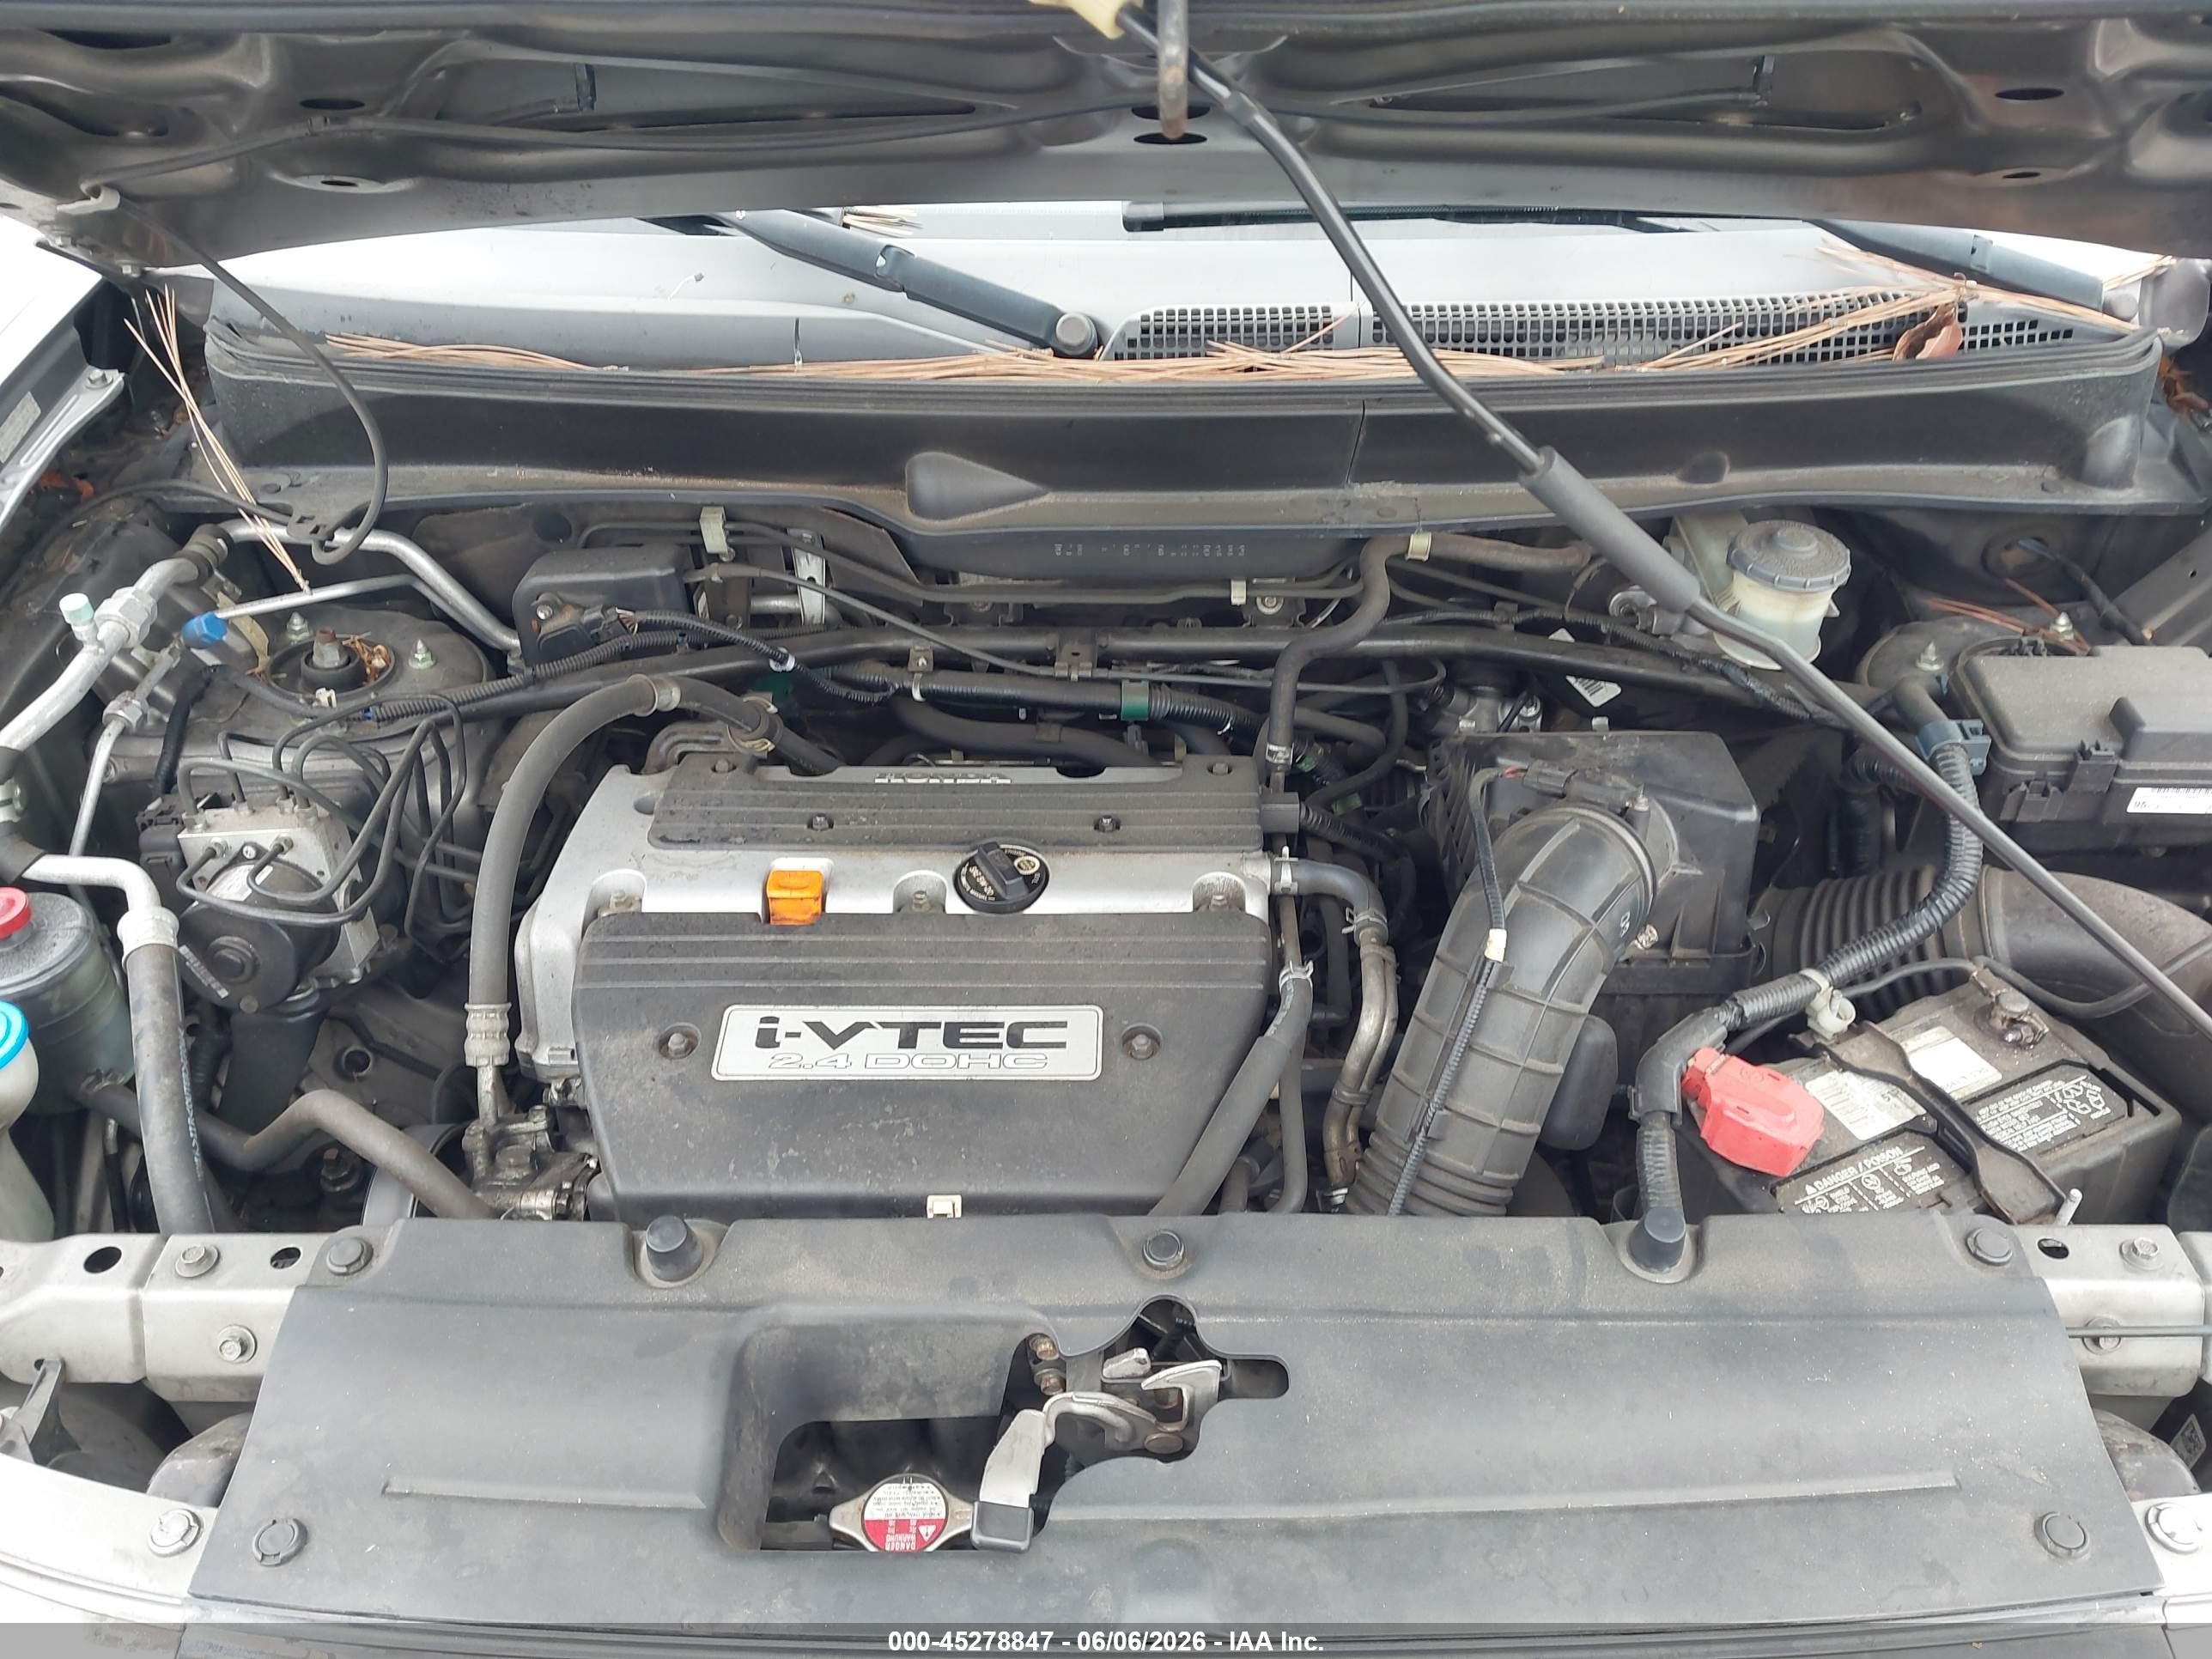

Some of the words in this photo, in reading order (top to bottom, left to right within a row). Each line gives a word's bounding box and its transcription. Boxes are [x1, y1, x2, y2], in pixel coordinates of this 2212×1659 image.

[755, 1016, 1068, 1050] i-VTEC
[769, 1053, 853, 1070] 2.4
[865, 1053, 1048, 1070] DOHC
[1814, 1166, 1858, 1191] DANGER
[1863, 1146, 1904, 1169] POISON
